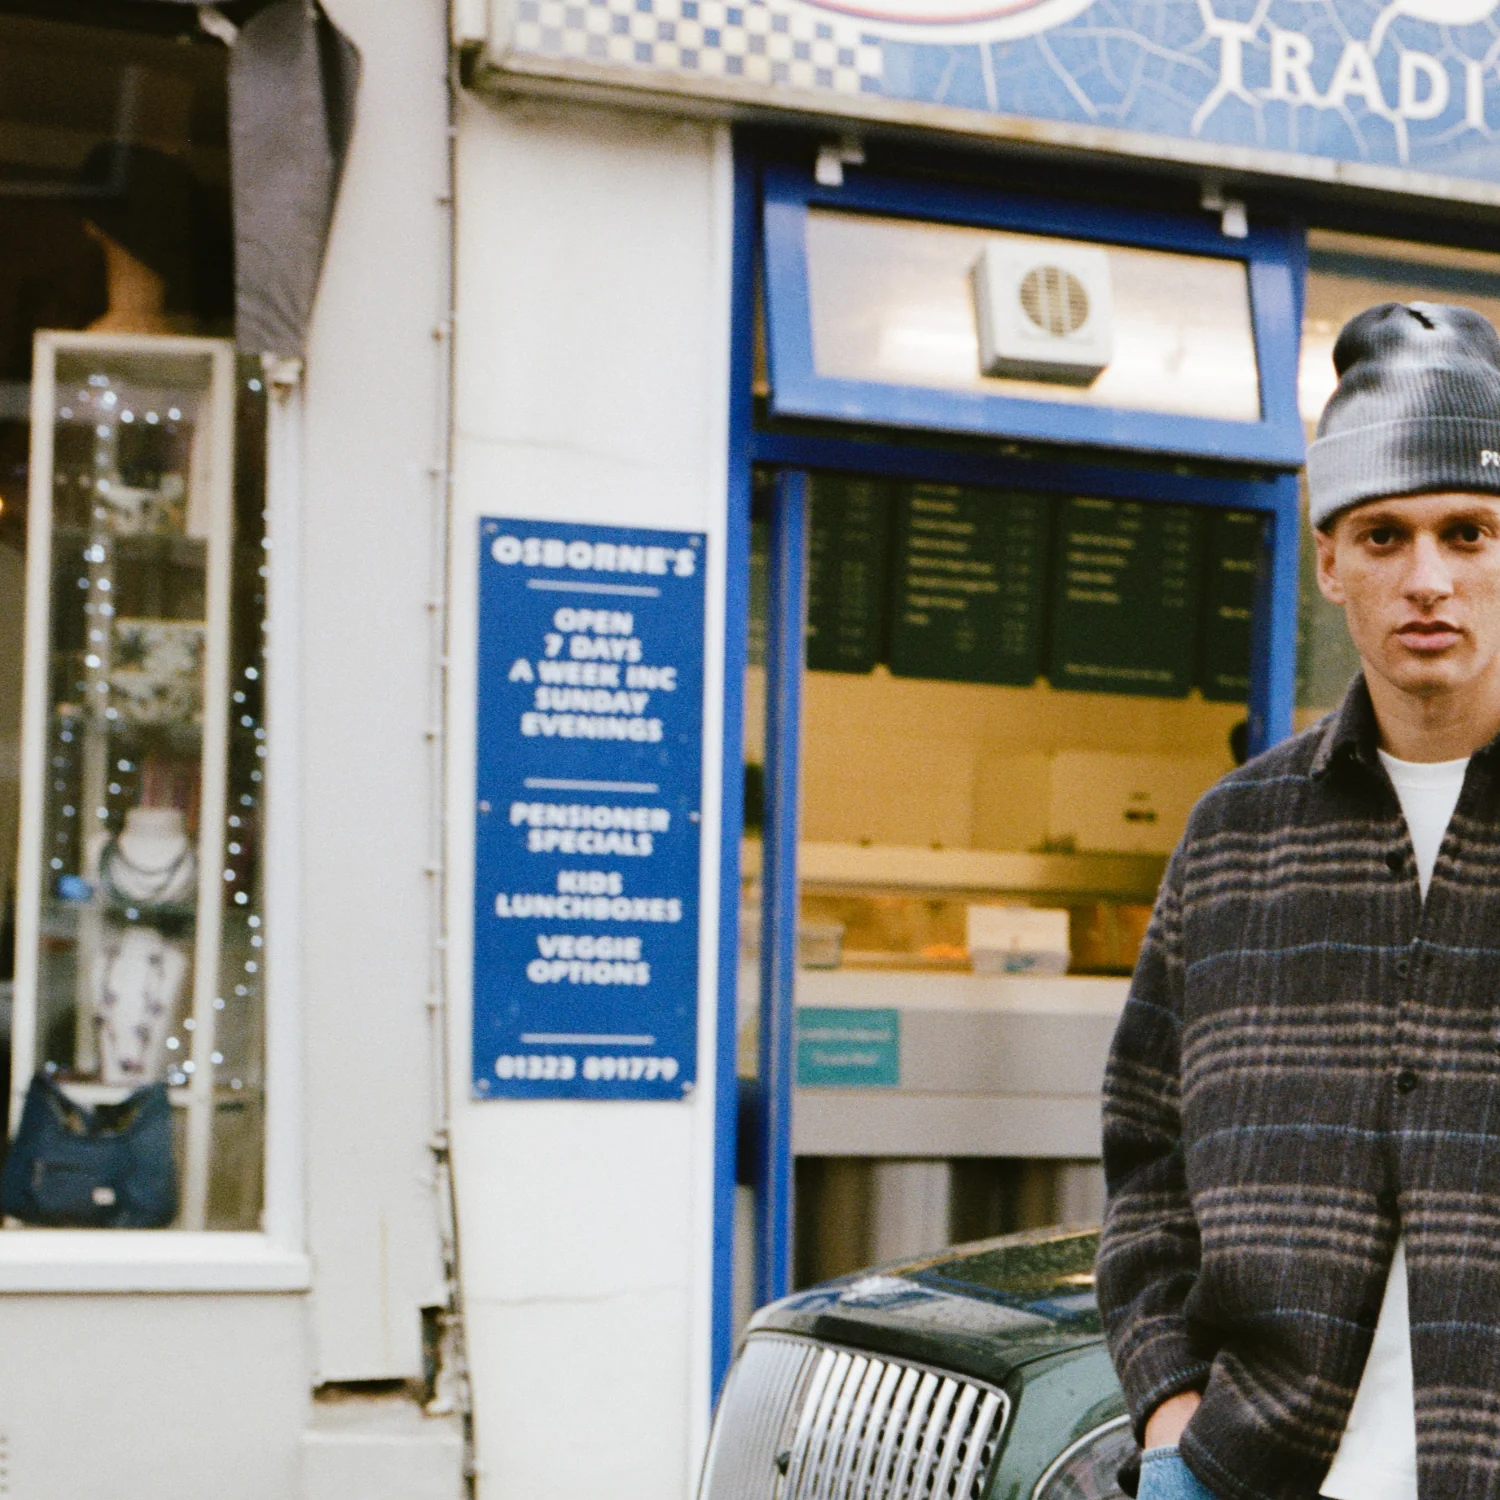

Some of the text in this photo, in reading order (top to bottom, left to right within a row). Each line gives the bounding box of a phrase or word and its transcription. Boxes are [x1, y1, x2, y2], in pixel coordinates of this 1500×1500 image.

[491, 536, 696, 576] OSBORNE'S
[554, 607, 634, 635] OPEN
[545, 633, 642, 663] 7 DAYS
[508, 658, 677, 692] A WEEK INC
[534, 685, 650, 715] SUNDAY
[520, 712, 663, 742] EVENINGS
[510, 802, 671, 832] PENSIONER
[527, 828, 653, 856] SPECIALS
[558, 870, 622, 896] KIDS
[495, 892, 682, 922] LUNCHBOXES
[536, 934, 642, 961] VEGGIE
[526, 958, 650, 985] OPTIONS
